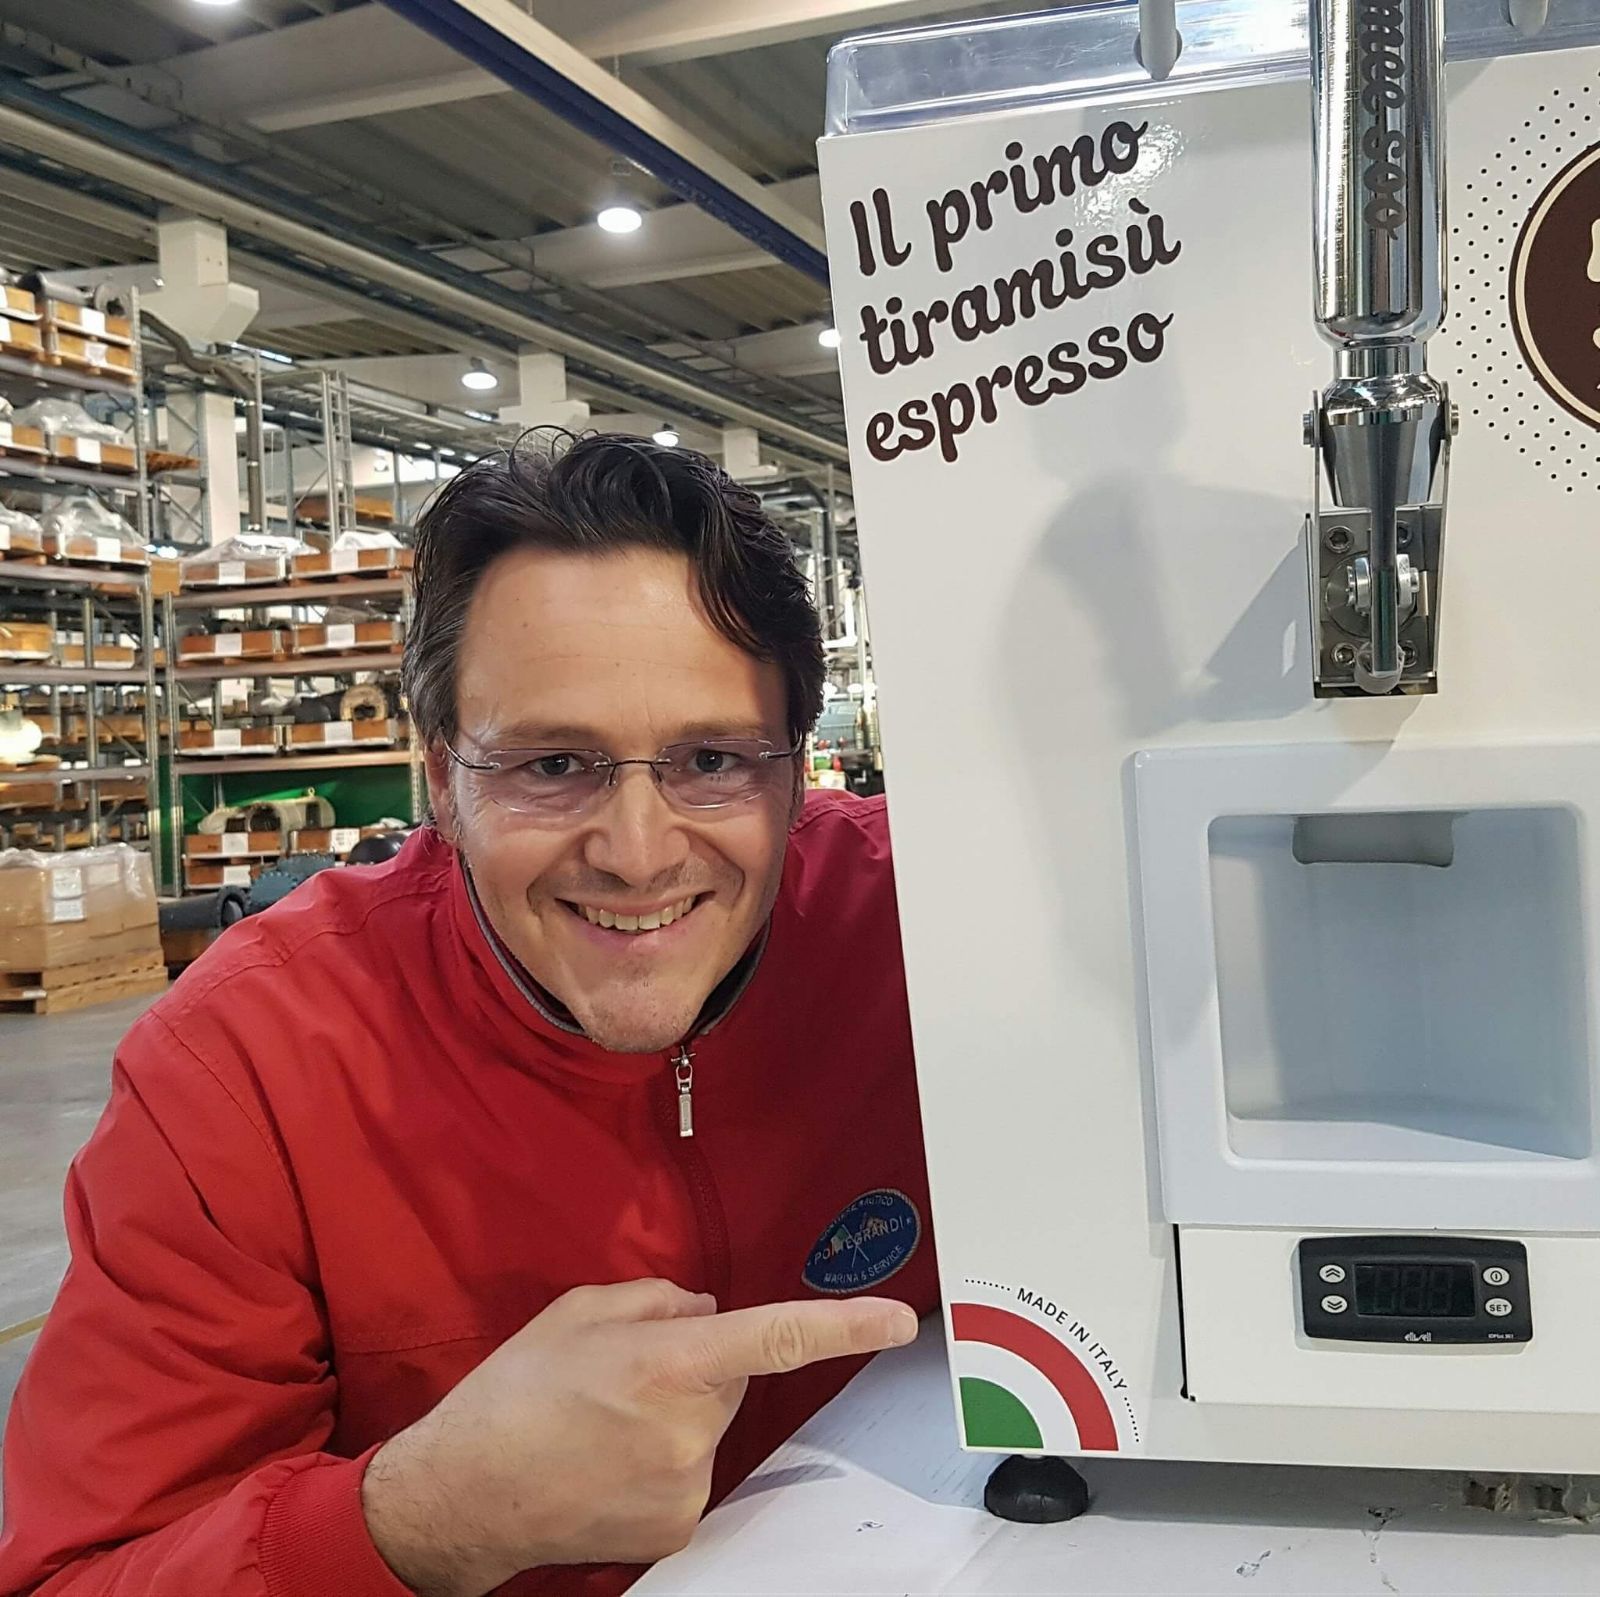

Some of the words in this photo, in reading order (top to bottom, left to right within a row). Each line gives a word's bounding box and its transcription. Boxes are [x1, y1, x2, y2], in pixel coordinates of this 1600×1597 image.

[849, 187, 912, 277] Il
[925, 120, 1149, 273] primo
[859, 197, 1183, 376] tiramisù
[865, 313, 1175, 464] espresso
[867, 1244, 905, 1278] SERVICE
[1489, 1303, 1509, 1313] SET
[1017, 1288, 1068, 1325] MADE
[1069, 1322, 1090, 1343] IN
[1088, 1343, 1127, 1390] ITALY
